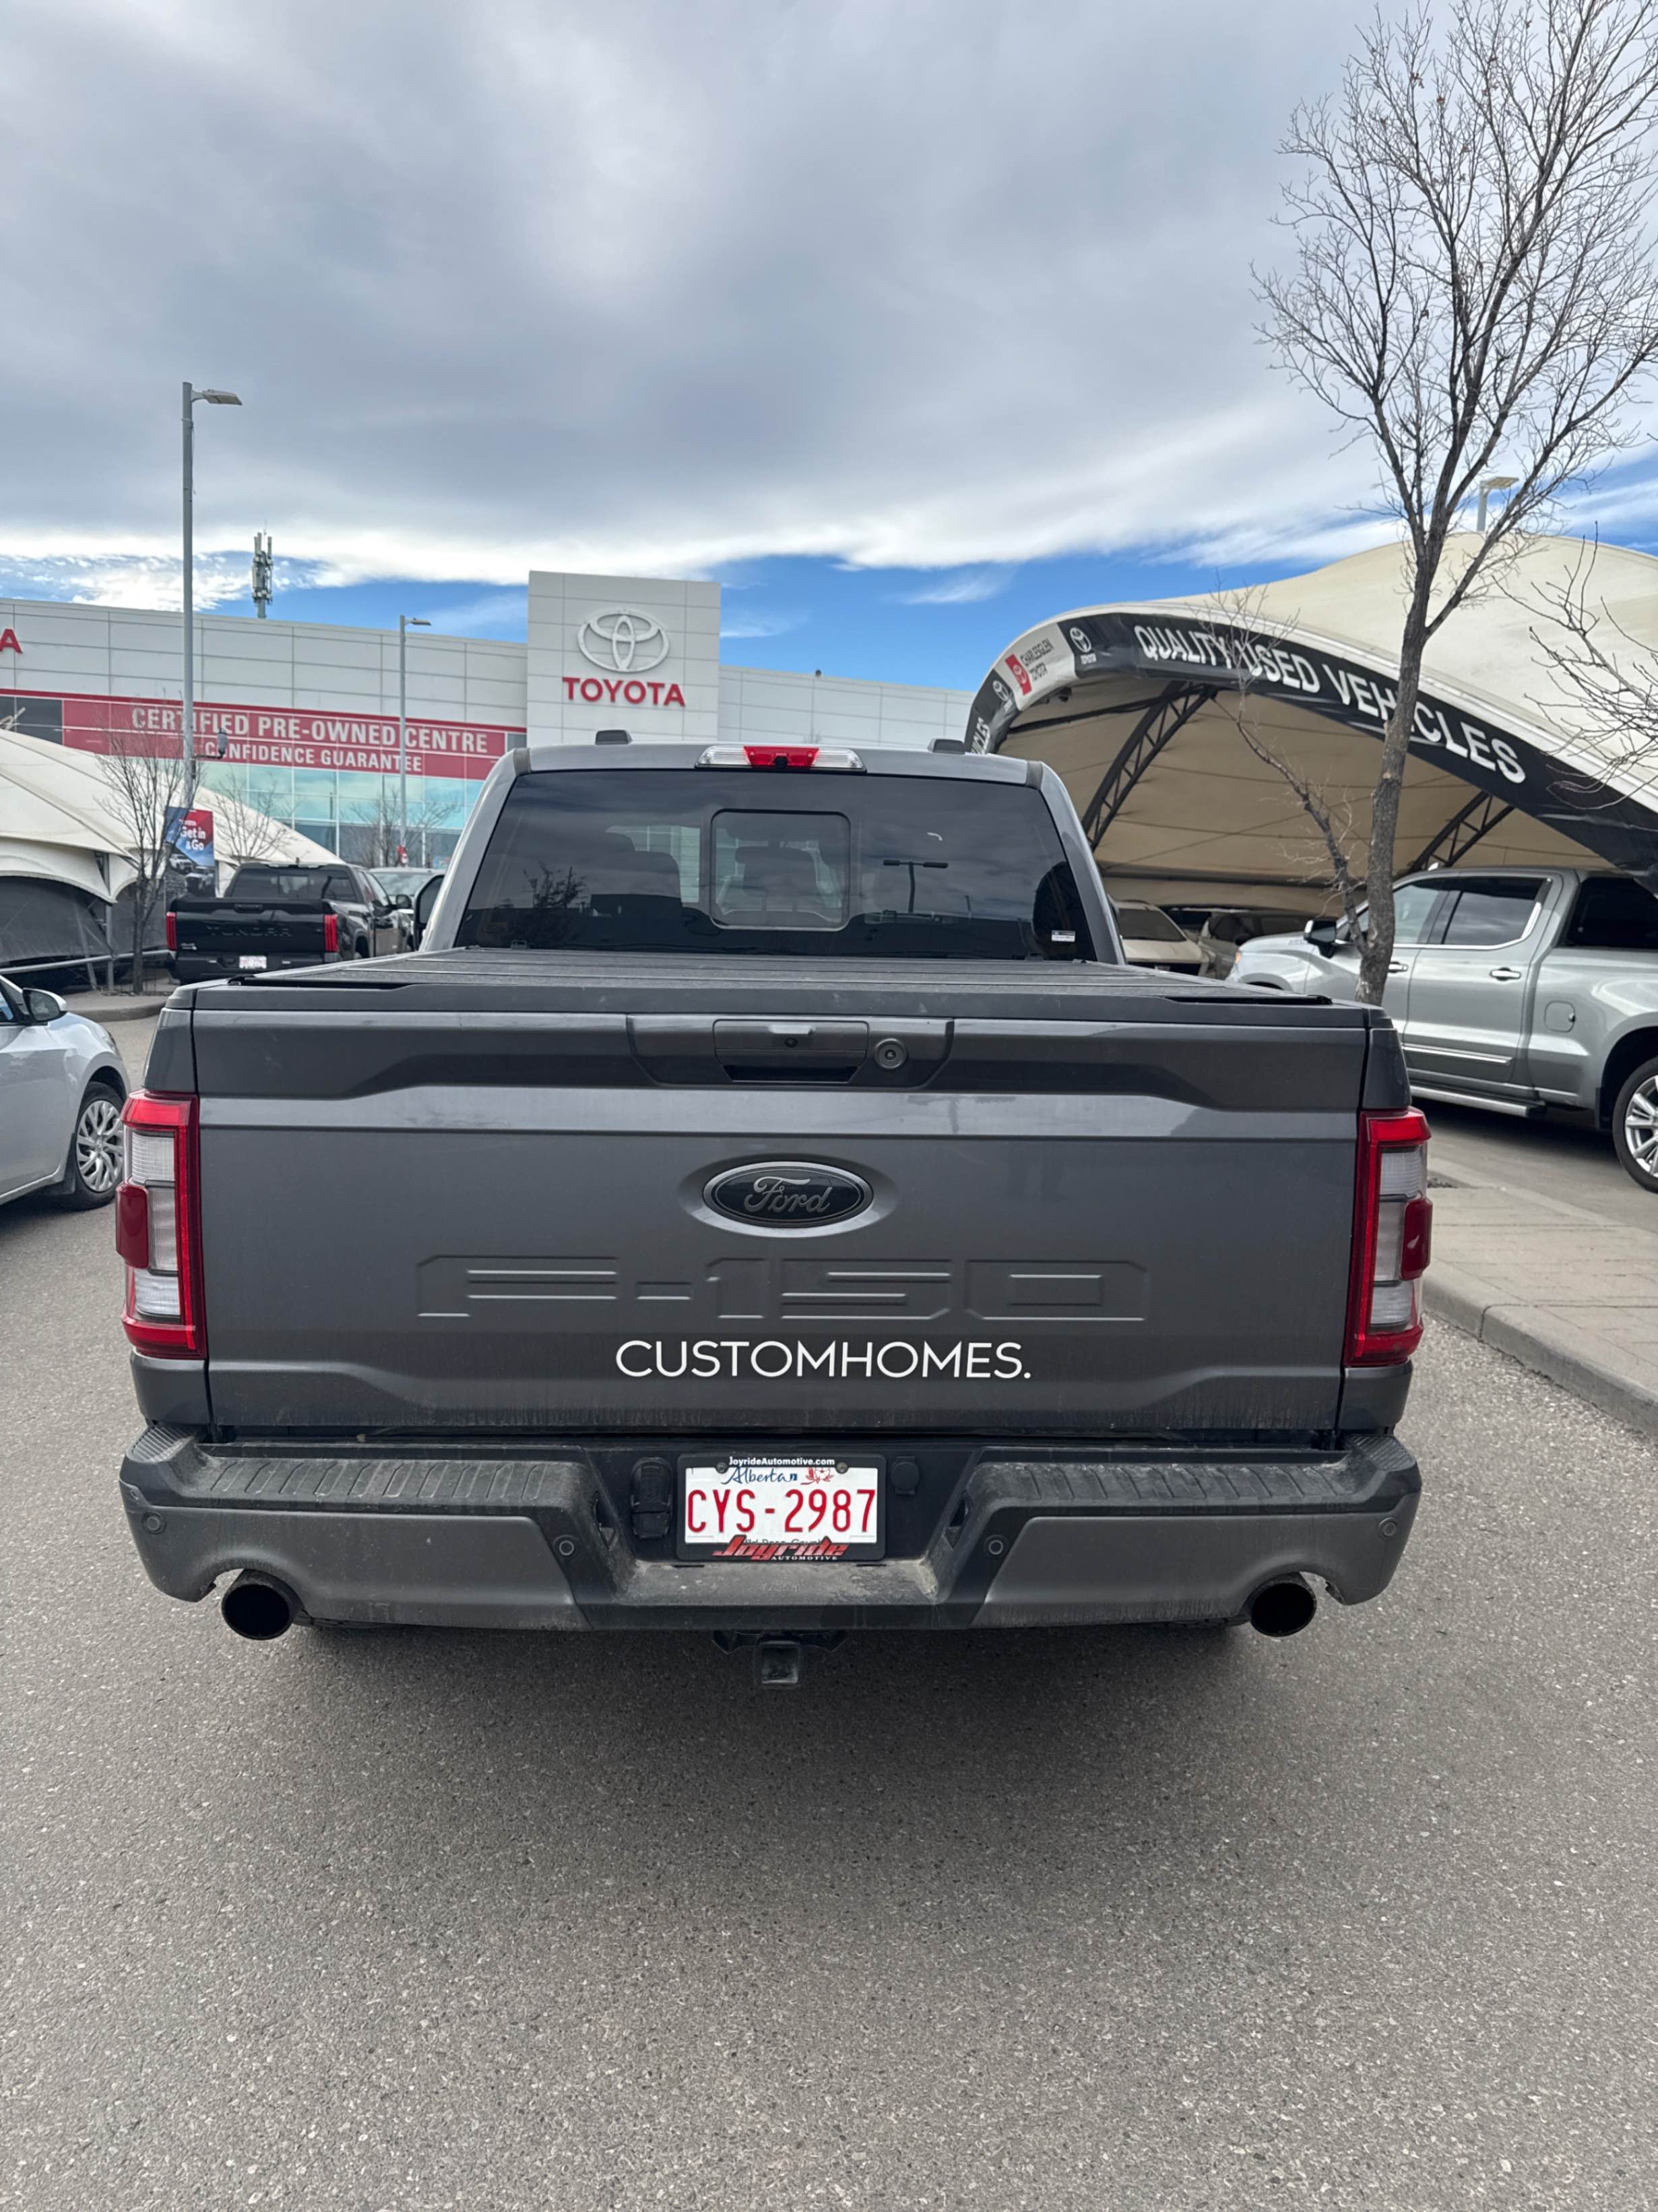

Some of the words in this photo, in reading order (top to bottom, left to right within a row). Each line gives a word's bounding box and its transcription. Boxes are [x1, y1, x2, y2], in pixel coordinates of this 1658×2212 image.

[562, 677, 686, 707] TOYOTA
[1134, 625, 1232, 669] QUALITY
[1235, 639, 1320, 693] USED
[1322, 663, 1526, 784] VEHCLES
[258, 716, 395, 746] PRE-OWNED
[405, 727, 488, 753] CENTRE
[204, 741, 315, 764] CNFIDENCE
[321, 749, 422, 772] GUARANTEE
[744, 1176, 833, 1212] Ford
[415, 1255, 1147, 1322] F-150
[615, 1339, 1031, 1379] CUSTOMHOMES.
[721, 1465, 792, 1485] Alberta
[728, 1456, 835, 1467] JoyrideAutomotive.com
[687, 1488, 876, 1533] CYS-2987
[711, 1534, 849, 1560] Joyride
